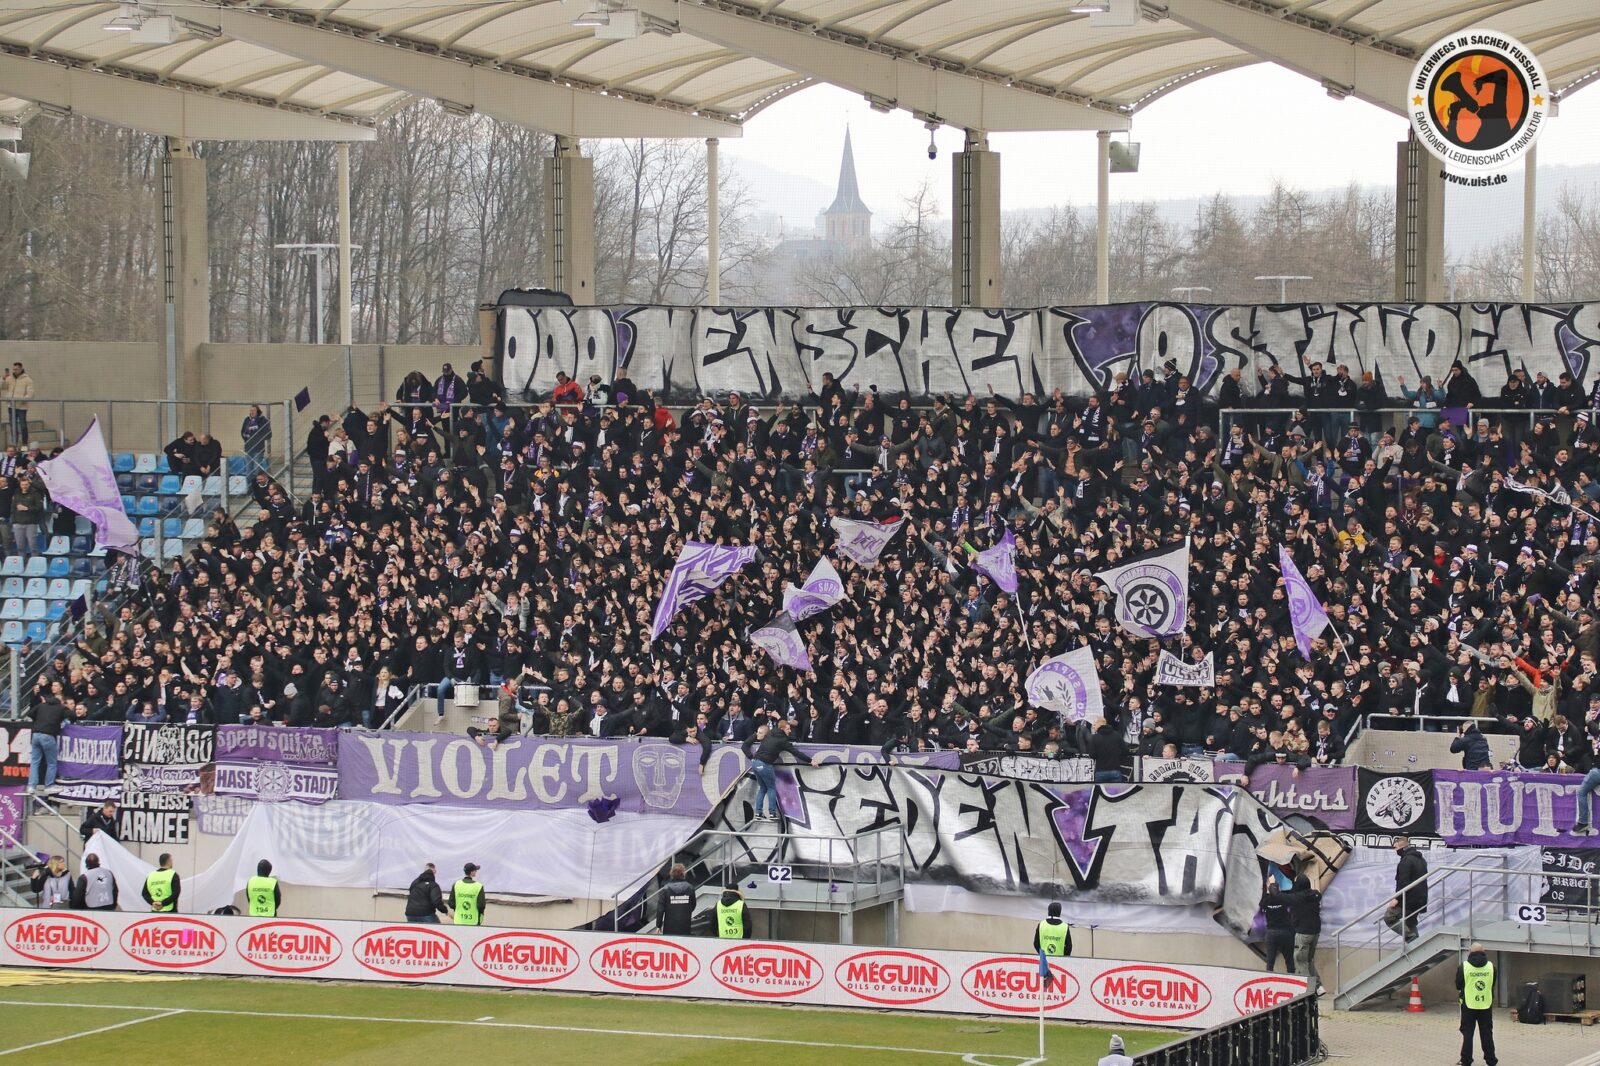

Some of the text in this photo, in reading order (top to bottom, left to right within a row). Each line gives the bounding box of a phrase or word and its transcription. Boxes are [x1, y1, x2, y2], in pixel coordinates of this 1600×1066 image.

[217, 769, 338, 794] HASE STADT
[358, 736, 619, 804] VIOLET
[1367, 778, 1424, 807] SOUTH TEXAS
[119, 812, 189, 844] ARMEE
[768, 866, 791, 881] C2
[1542, 850, 1597, 874] SIDE
[1551, 890, 1565, 901] 08
[1518, 905, 1545, 922] C3
[16, 923, 98, 946] MÉGUIN
[131, 927, 215, 950] MÉGUIN
[248, 931, 331, 955] MÉGUIN
[131, 948, 152, 956] OILS
[365, 936, 450, 960] MÉGUIN
[483, 942, 568, 966] MÉGUIN
[405, 959, 450, 967] GERMANY
[483, 963, 504, 971] OILS
[523, 965, 568, 973] GERMANY
[601, 948, 688, 972] MÉGUIN
[722, 954, 812, 979] MÉGUIN
[601, 969, 622, 977] OILS
[642, 971, 688, 980] GERMANY
[765, 978, 812, 987] GERMANY
[847, 961, 938, 986] MÉGUIN
[974, 968, 1067, 994] MÉGUN
[847, 983, 869, 991] OILS
[890, 985, 938, 994] GERMANY
[974, 990, 997, 998] OILS
[1018, 992, 1067, 1002] GERANY
[1104, 975, 1199, 1003] MÉGUIN
[1104, 997, 1198, 1011] OILS OF GERMANY
